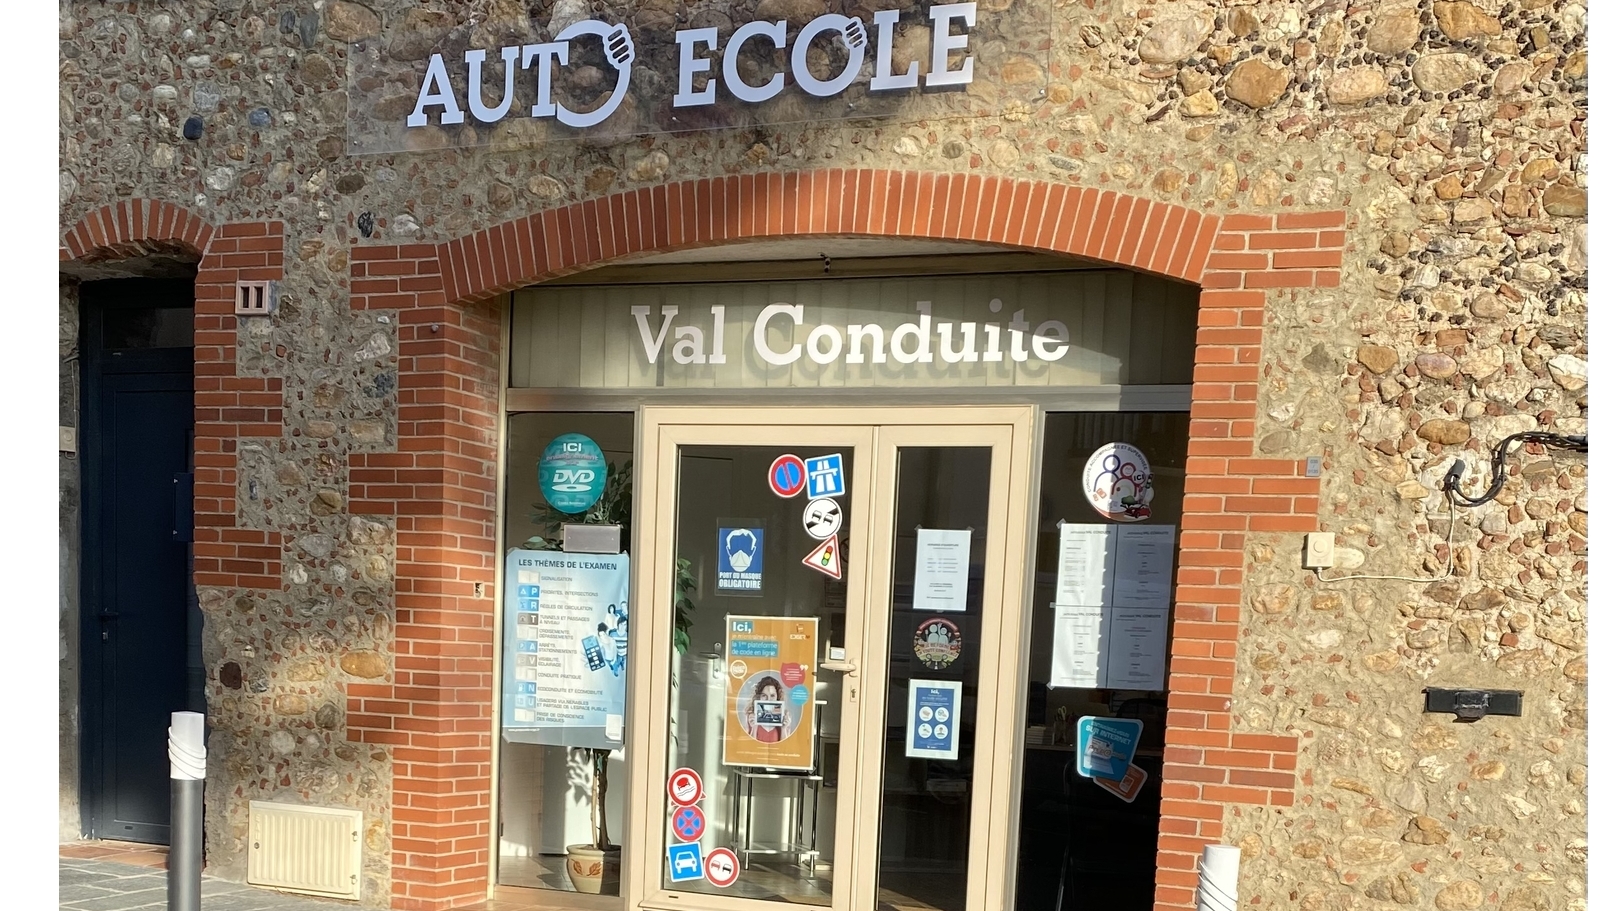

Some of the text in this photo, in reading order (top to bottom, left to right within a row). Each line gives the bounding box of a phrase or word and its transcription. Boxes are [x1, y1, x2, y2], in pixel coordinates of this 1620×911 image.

[407, 2, 977, 127] AUTO ECOLE
[630, 298, 1070, 366] Val Conduite
[563, 442, 582, 452] ICI
[552, 470, 595, 484] DVD
[518, 558, 532, 566] LES
[580, 562, 617, 570] L'EXAMEN
[719, 579, 761, 588] OBLIGATOIRE
[732, 621, 752, 634] Ici,
[1086, 725, 1131, 745] SUR INTERNET
